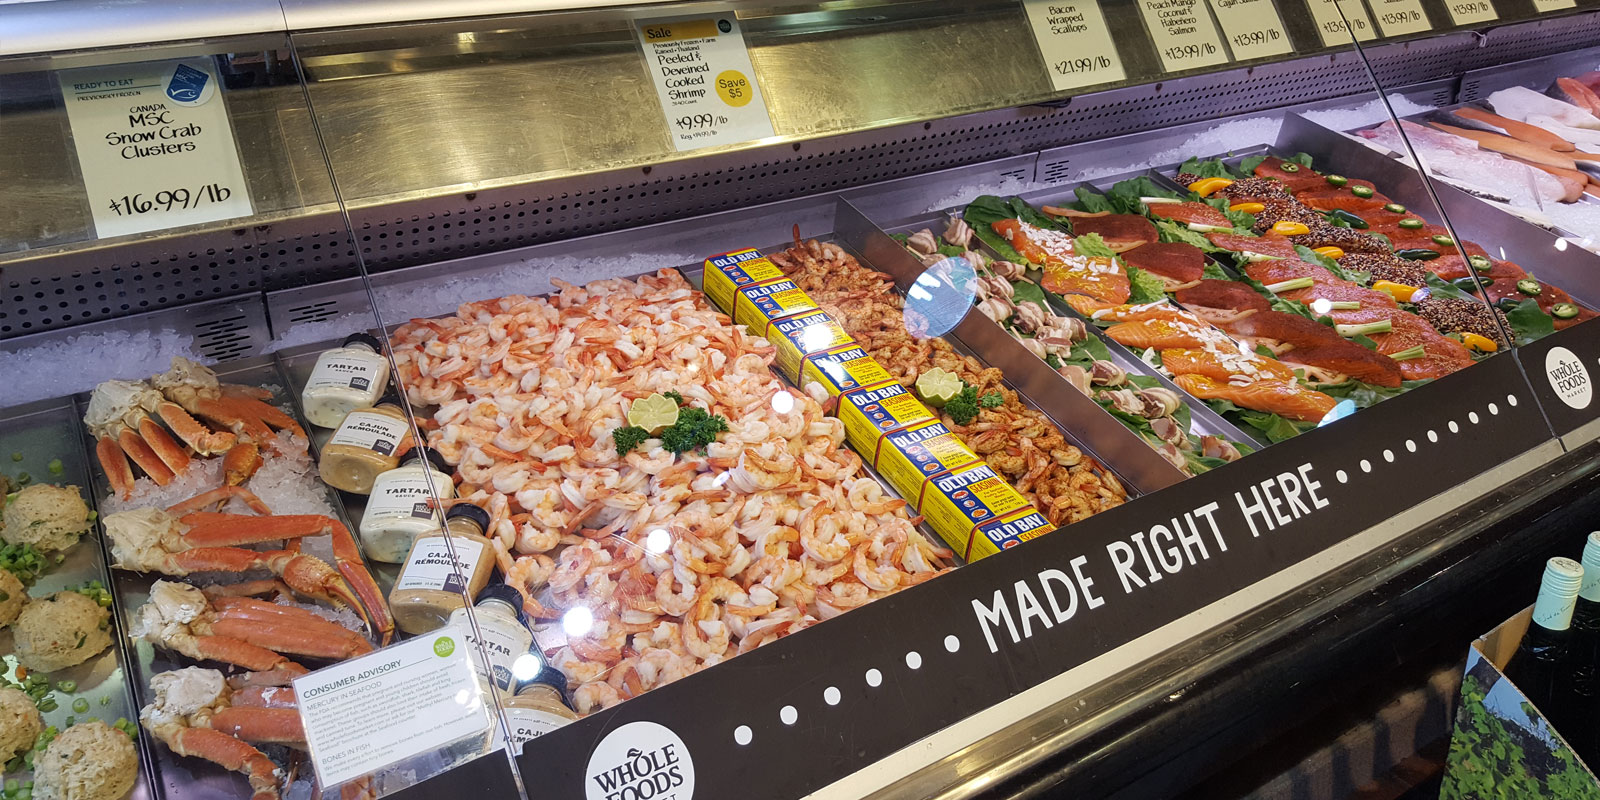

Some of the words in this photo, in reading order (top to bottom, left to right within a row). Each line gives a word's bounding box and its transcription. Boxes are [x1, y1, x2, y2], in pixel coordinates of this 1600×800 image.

[1048, 6, 1076, 15] Bacon
[1146, 0, 1170, 10] Peach
[1170, 0, 1196, 8] Mango
[1218, 0, 1238, 8] Cajun
[1453, 2, 1488, 15] $13.99/lb
[1046, 13, 1084, 24] Wrapped
[1158, 8, 1187, 18] Coconut
[1382, 10, 1420, 24] $13.99/lb
[647, 28, 672, 39] Sale
[1051, 24, 1087, 35] Scallops
[1168, 26, 1196, 35] Salmon
[1233, 28, 1279, 46] $13.99/lb
[652, 41, 680, 49] Previously
[1165, 42, 1216, 60] $13.99/lb
[657, 52, 694, 65] Peeled
[1054, 56, 1110, 74] $21.99/lb
[662, 63, 710, 76] Deveined
[74, 82, 102, 90] READY
[665, 75, 704, 89] Cooked
[719, 78, 745, 89] Save
[668, 88, 706, 100] Shrimp
[728, 89, 742, 99] $5
[130, 104, 166, 113] CANADA
[128, 111, 174, 128] MSC
[676, 113, 728, 130] $9.99/lb
[105, 131, 155, 146] Snow
[159, 123, 202, 140] Crab
[121, 140, 196, 159] Clusters
[108, 183, 231, 216] $16.99/lb
[714, 256, 738, 267] OLD
[736, 251, 759, 262] BAY
[746, 288, 771, 298] OLD
[770, 282, 793, 292] BAY
[779, 320, 804, 332] OLD
[803, 313, 826, 326] BAY
[839, 349, 864, 361] BAY
[327, 363, 367, 372] TARTAR
[1550, 360, 1581, 381] WHOLE
[1557, 372, 1586, 393] FOODS
[852, 392, 880, 406] OLD
[877, 385, 904, 398] BAY
[1567, 387, 1586, 398] MARKET
[347, 425, 398, 440] RÉMOULADE
[359, 422, 389, 431] CAJUN
[893, 432, 922, 448] OLD
[919, 424, 946, 438] BAY
[938, 475, 968, 492] OLD
[966, 466, 994, 483] BAY
[987, 524, 1018, 541] OLD
[1014, 514, 1044, 532] BAY
[971, 554, 1106, 654] MADE
[1106, 501, 1228, 593] RIGHT
[1234, 462, 1329, 538] HERE
[302, 675, 356, 698] CONSUMER
[356, 659, 402, 680] ADVISORY
[306, 695, 339, 711] MERCURY
[348, 680, 382, 696] SEAFOOD
[321, 751, 346, 764] BONES
[355, 742, 370, 751] FISH
[593, 744, 679, 793] WHOLE
